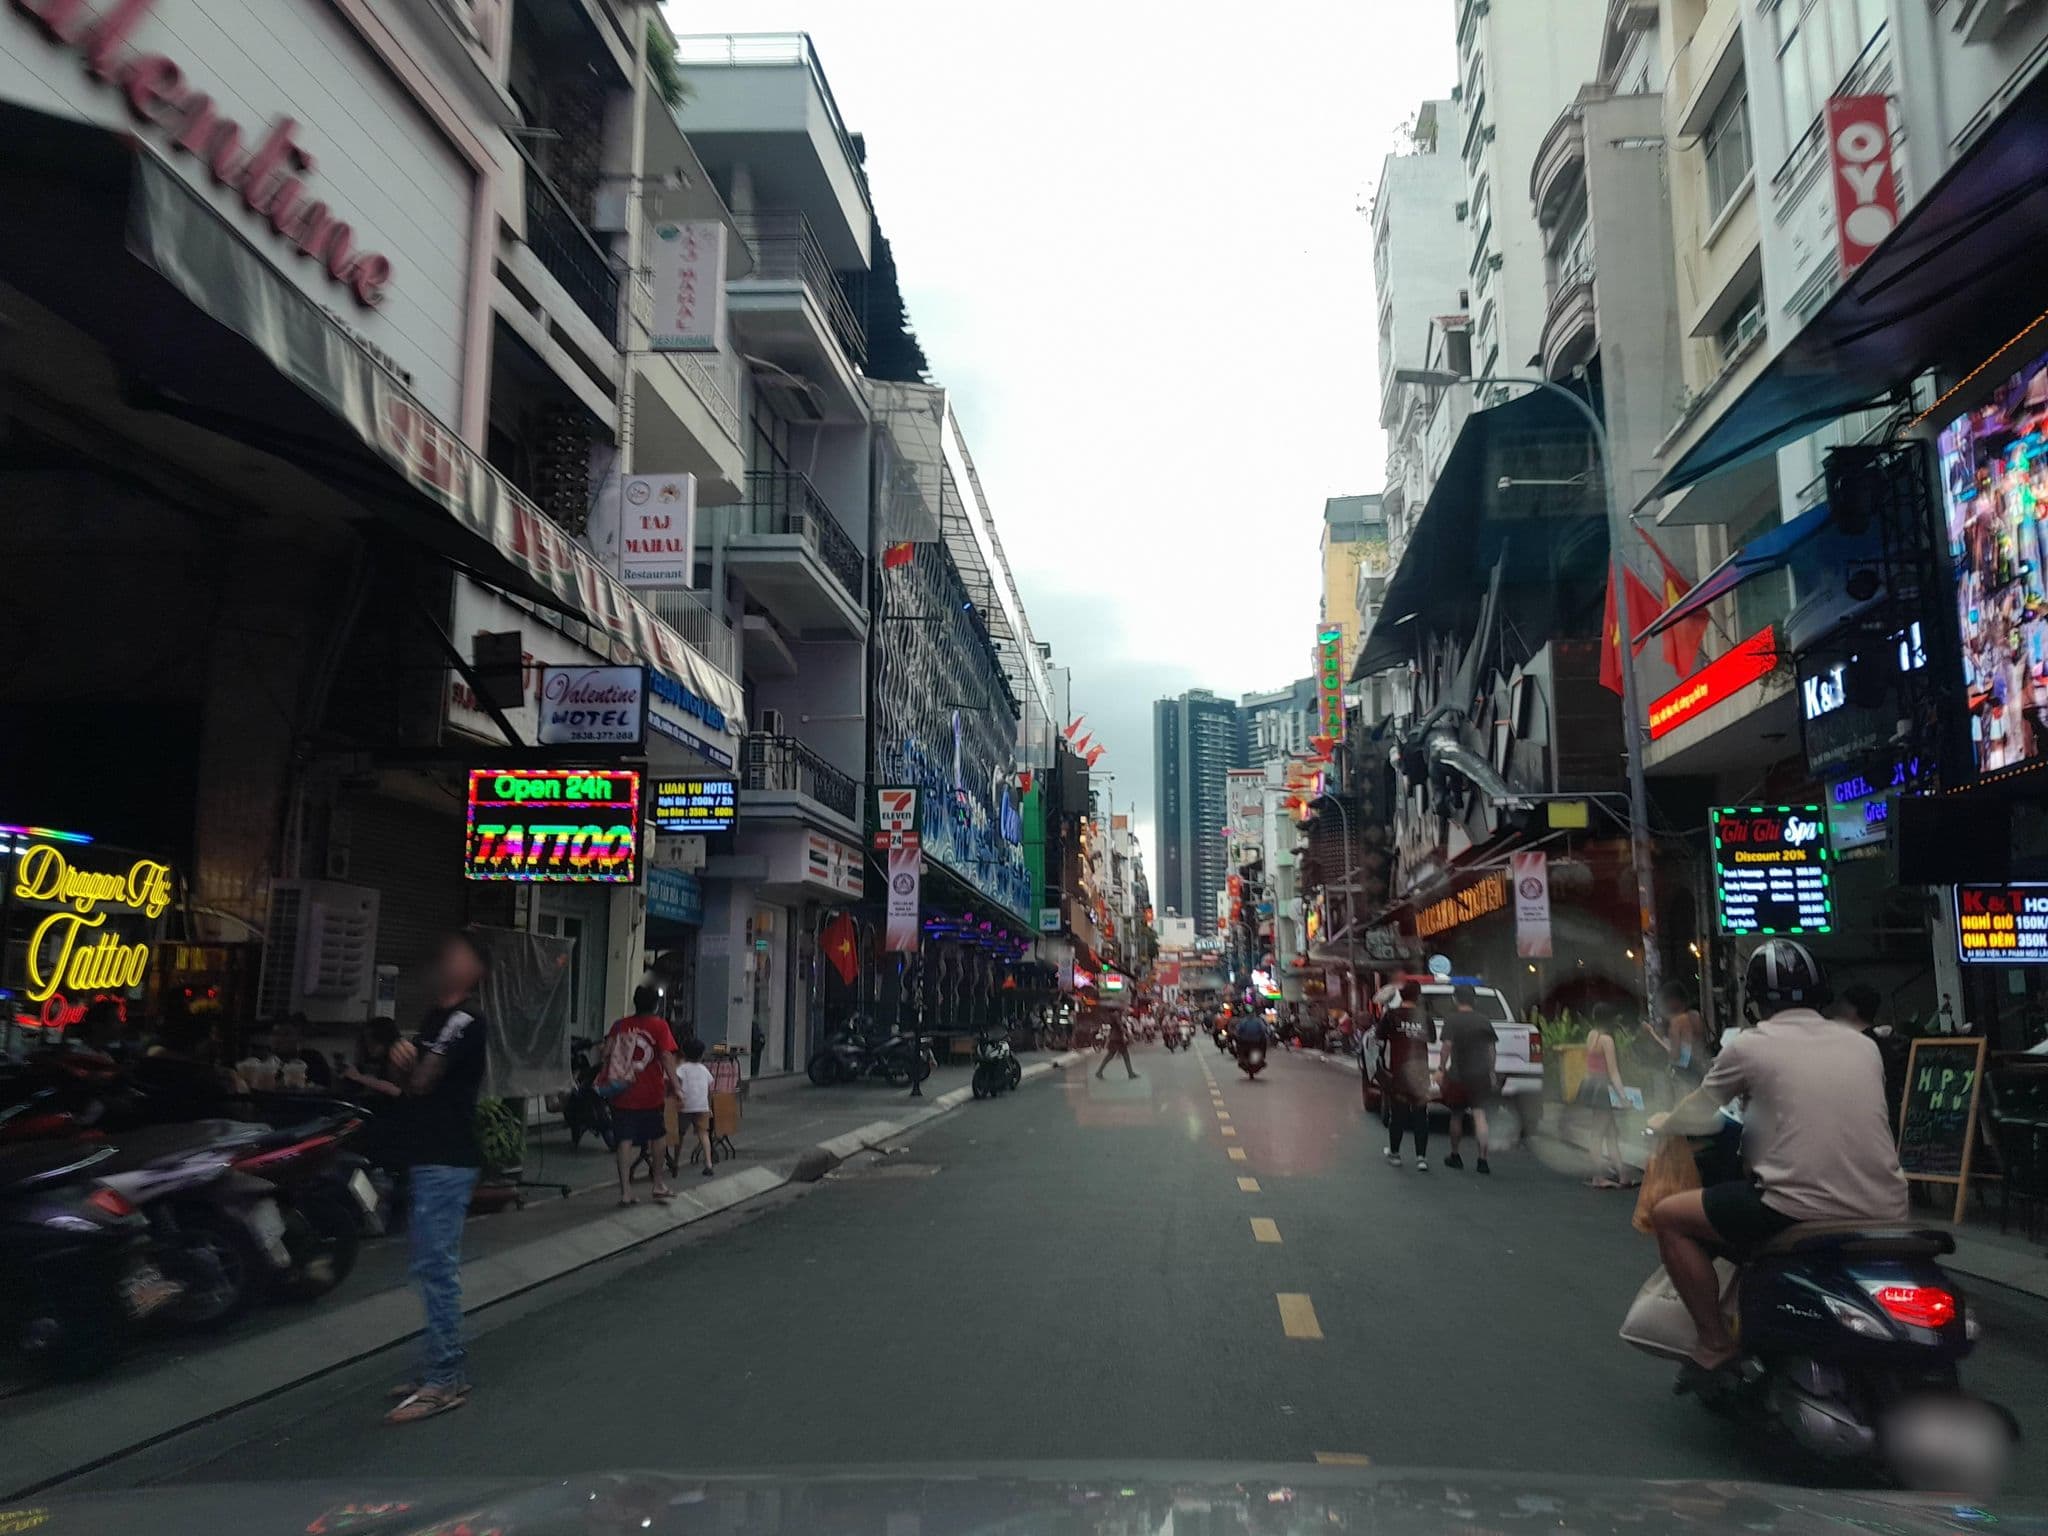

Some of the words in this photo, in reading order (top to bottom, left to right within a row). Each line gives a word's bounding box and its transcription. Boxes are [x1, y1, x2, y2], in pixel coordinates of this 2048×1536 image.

[1837, 121, 1895, 247] OYO
[641, 515, 672, 530] TAJ
[626, 538, 683, 553] MAHAL
[624, 568, 682, 580] Restaurant
[545, 670, 637, 706] Valentine
[552, 711, 630, 726] HOTEL
[495, 776, 561, 803] Open
[566, 776, 612, 799] 24h
[658, 782, 686, 795] LUAN
[688, 782, 702, 795] VU
[703, 782, 735, 795] HOTEL
[883, 792, 911, 811] 7
[891, 834, 902, 845] 24
[1784, 816, 1816, 846] Spa
[474, 825, 632, 866] TATTOO
[1735, 851, 1780, 863] Discount
[1782, 849, 1806, 861] 20%
[15, 844, 126, 913] Dragon
[127, 859, 171, 919] Fly
[1963, 933, 1988, 949] QUA
[2018, 933, 2048, 948] 350K
[27, 912, 149, 1002] Tattoo
